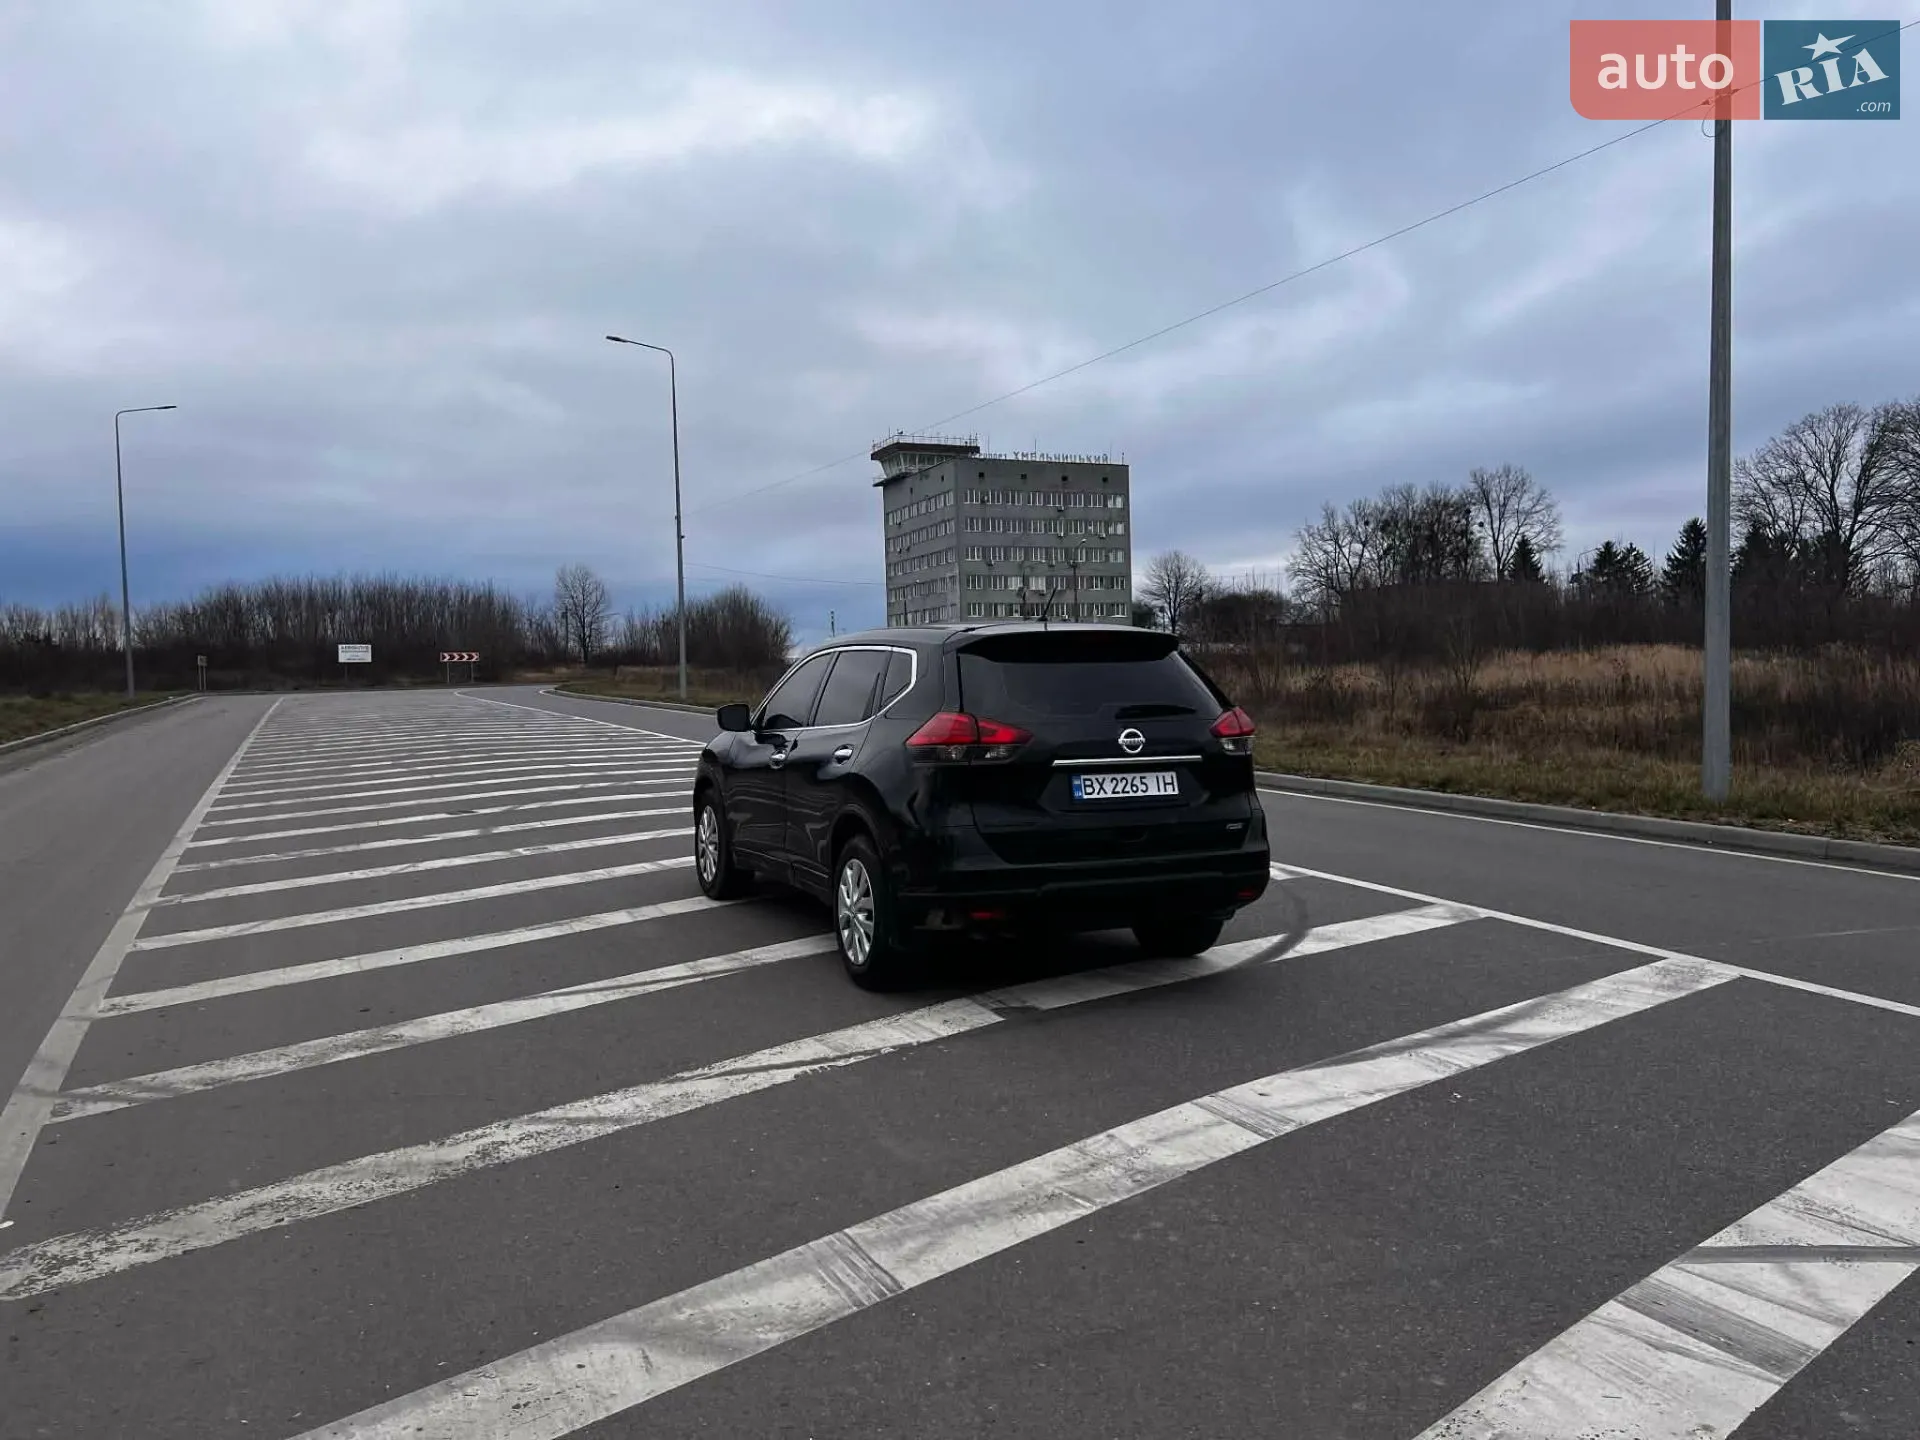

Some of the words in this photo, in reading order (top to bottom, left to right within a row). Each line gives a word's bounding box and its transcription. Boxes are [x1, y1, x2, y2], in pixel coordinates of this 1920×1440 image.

[1083, 777, 1108, 796] BX
[1110, 775, 1149, 795] 2265
[1155, 774, 1176, 793] IH
